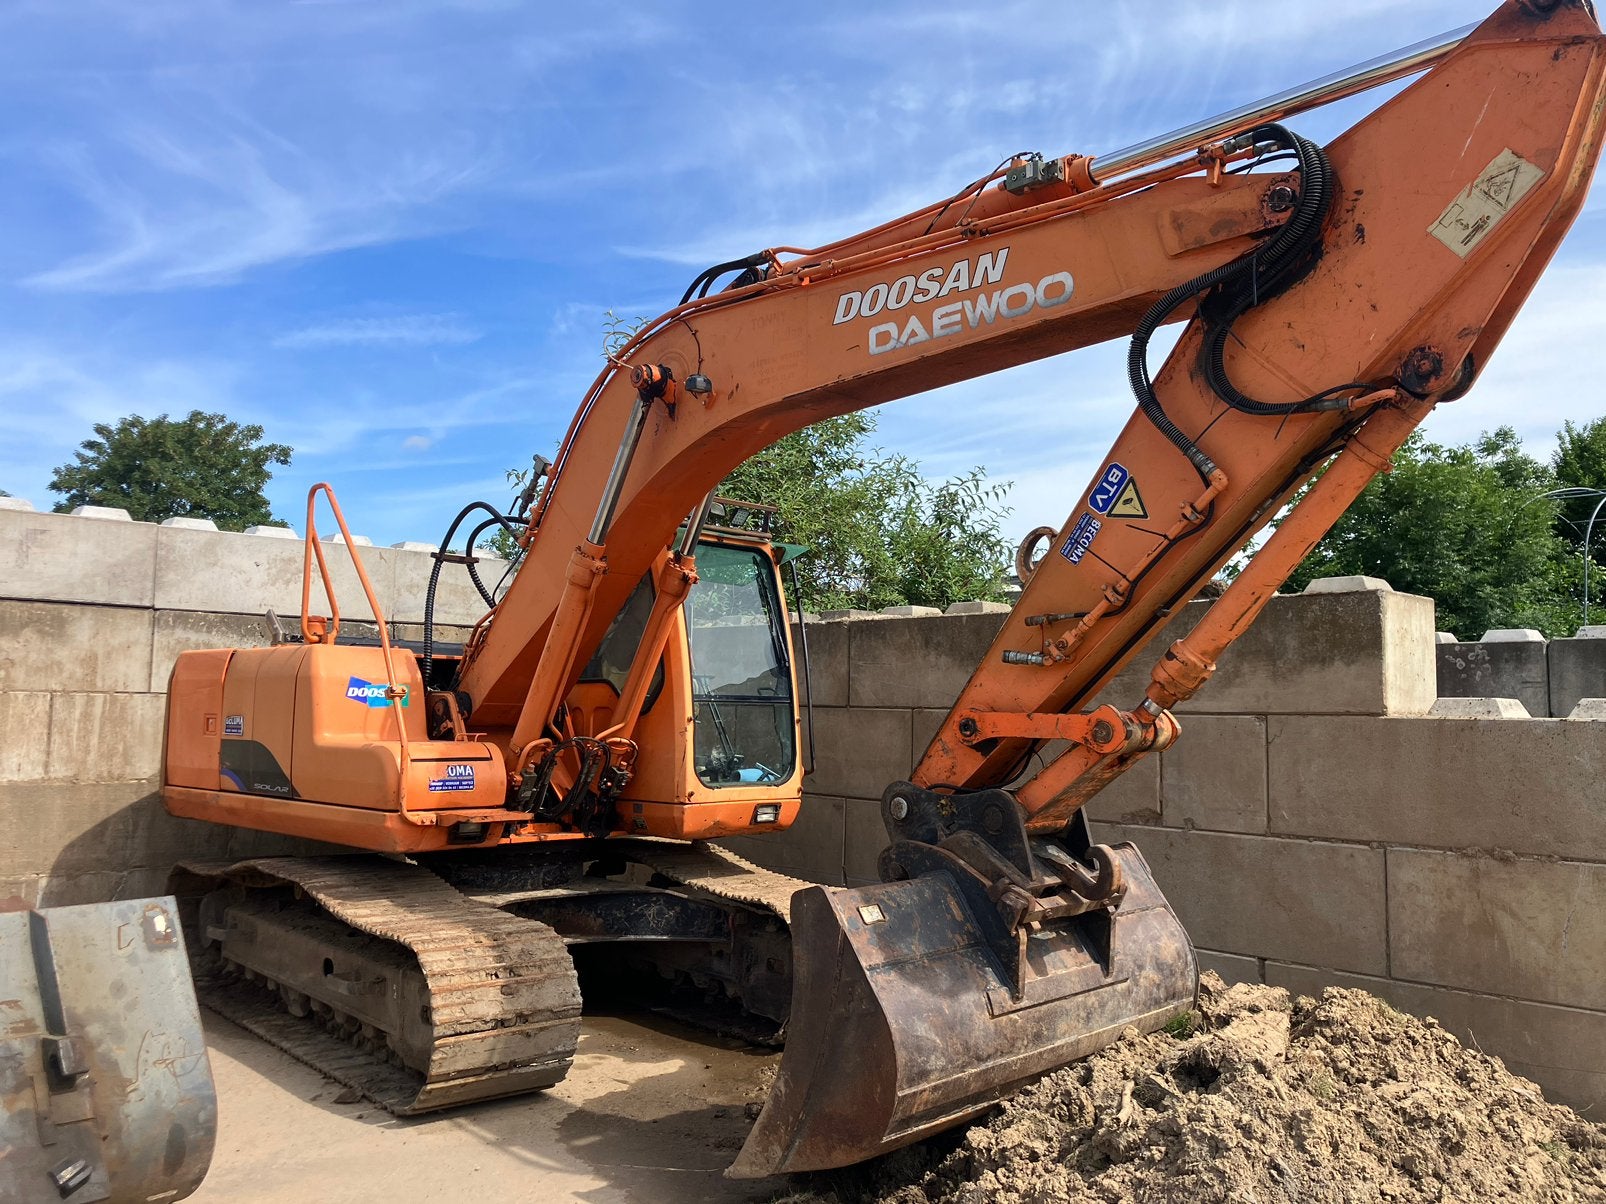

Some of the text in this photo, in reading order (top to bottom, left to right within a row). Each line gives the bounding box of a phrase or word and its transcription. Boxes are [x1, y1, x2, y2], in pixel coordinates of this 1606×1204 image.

[832, 247, 1010, 326] DOOSAN
[868, 271, 1075, 357] DAEWOO
[1095, 467, 1122, 508] BTV
[1069, 519, 1102, 563] BECOMA
[346, 686, 387, 698] DOOS
[253, 782, 289, 794] SOLAR
[448, 765, 473, 776] OMA
